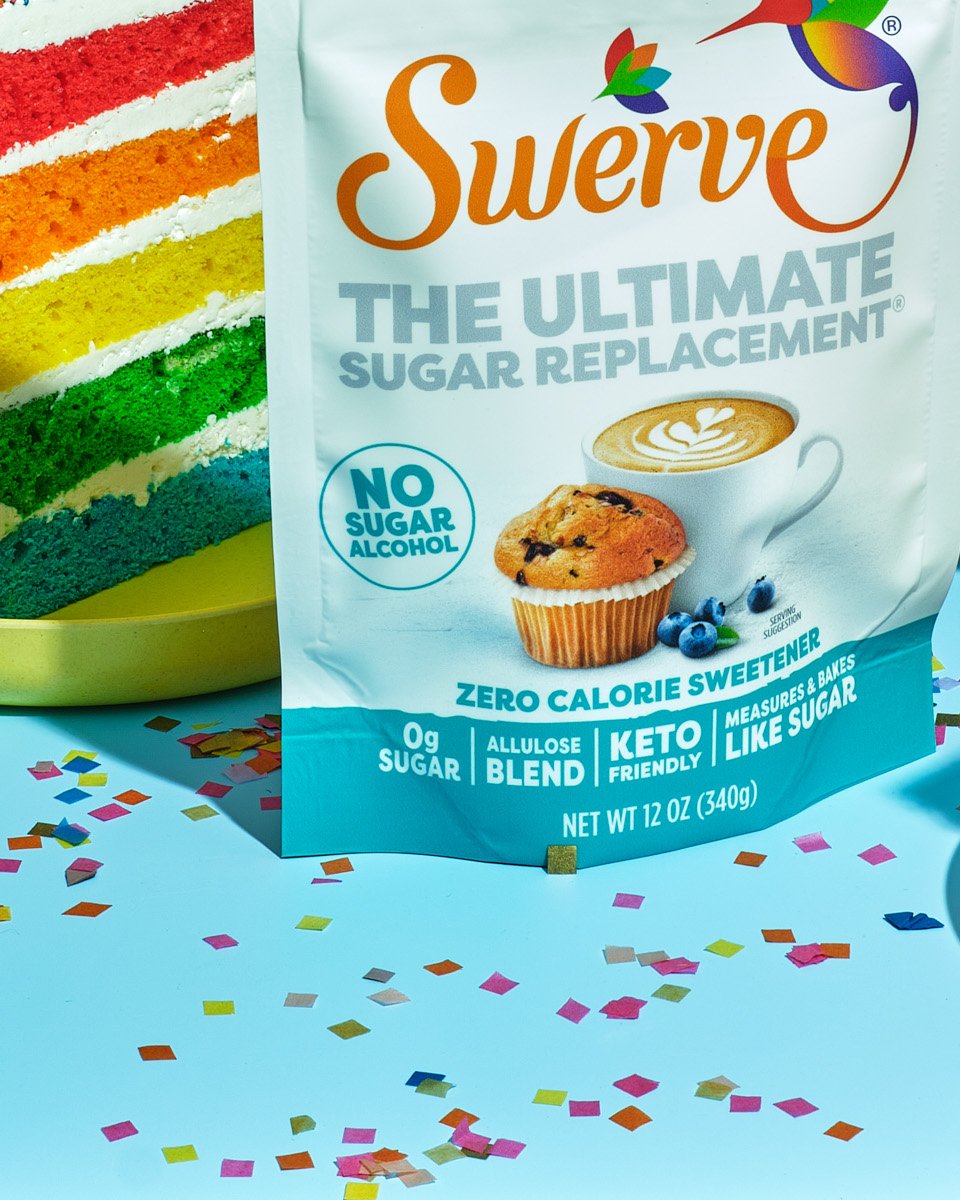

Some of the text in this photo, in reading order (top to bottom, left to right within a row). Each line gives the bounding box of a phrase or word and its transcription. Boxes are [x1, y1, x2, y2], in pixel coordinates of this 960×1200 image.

[336, 53, 918, 251] Swerve
[338, 231, 896, 345] THE ULTIMATE
[338, 350, 524, 392] SUGAR
[350, 463, 436, 510] NO
[345, 510, 456, 537] SUGAR
[349, 532, 460, 559] ALCOHOL
[763, 610, 802, 640] SUGGESTION
[769, 603, 797, 627] SERVING
[456, 626, 821, 712] ZERO CALORIE SWEETENER
[724, 653, 856, 729] MEASURES & BAKES
[725, 675, 857, 761] LIKE SUGAR
[403, 721, 439, 754] 0g
[486, 735, 581, 754] ALLULOSE
[610, 719, 702, 762] KETO
[378, 748, 462, 782] SUGAR
[486, 758, 585, 787] BLEND
[608, 751, 702, 784] FRIENDLY
[563, 779, 758, 838] NET WT 12 OZ (340g)
